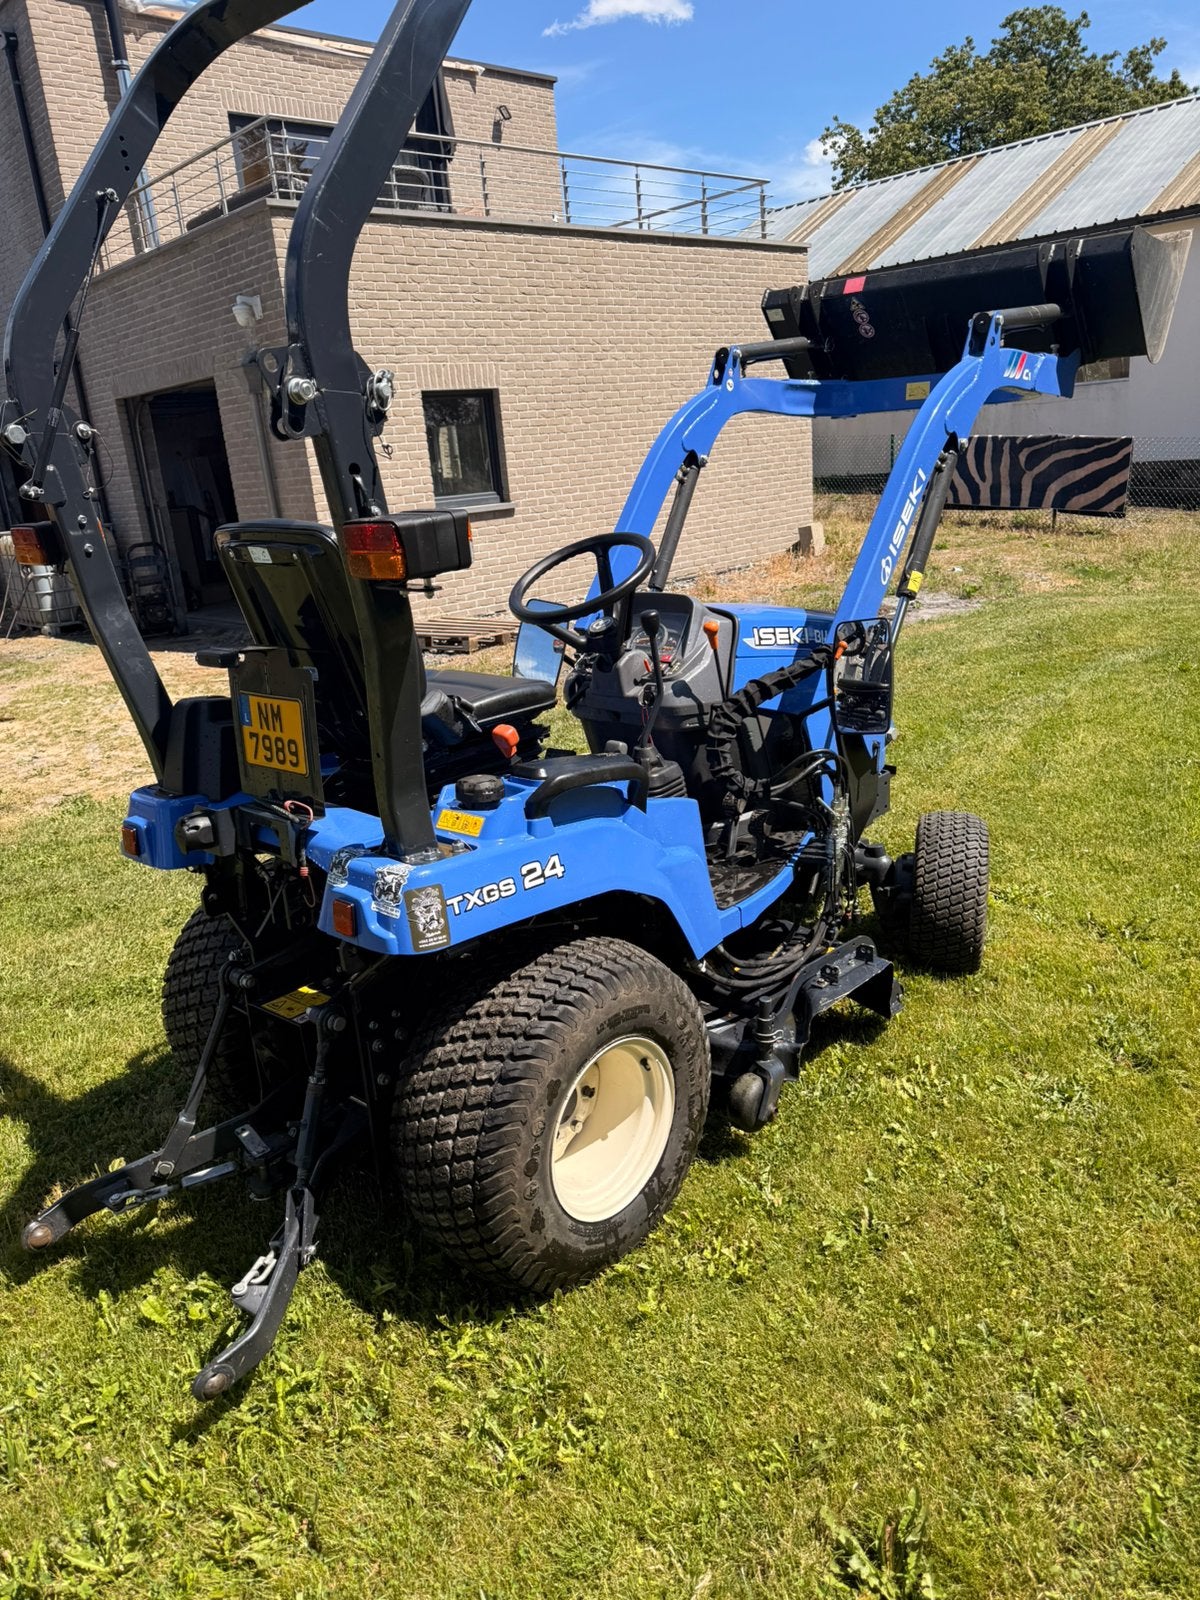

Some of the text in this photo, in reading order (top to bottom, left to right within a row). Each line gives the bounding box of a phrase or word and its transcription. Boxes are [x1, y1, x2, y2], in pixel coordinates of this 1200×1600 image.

[888, 467, 926, 557] ISEKI
[752, 626, 809, 646] ISEKI
[244, 711, 250, 723] L
[257, 702, 283, 733] NM
[249, 732, 300, 768] 7989
[446, 877, 517, 916] TXGS
[520, 853, 566, 891] 24
